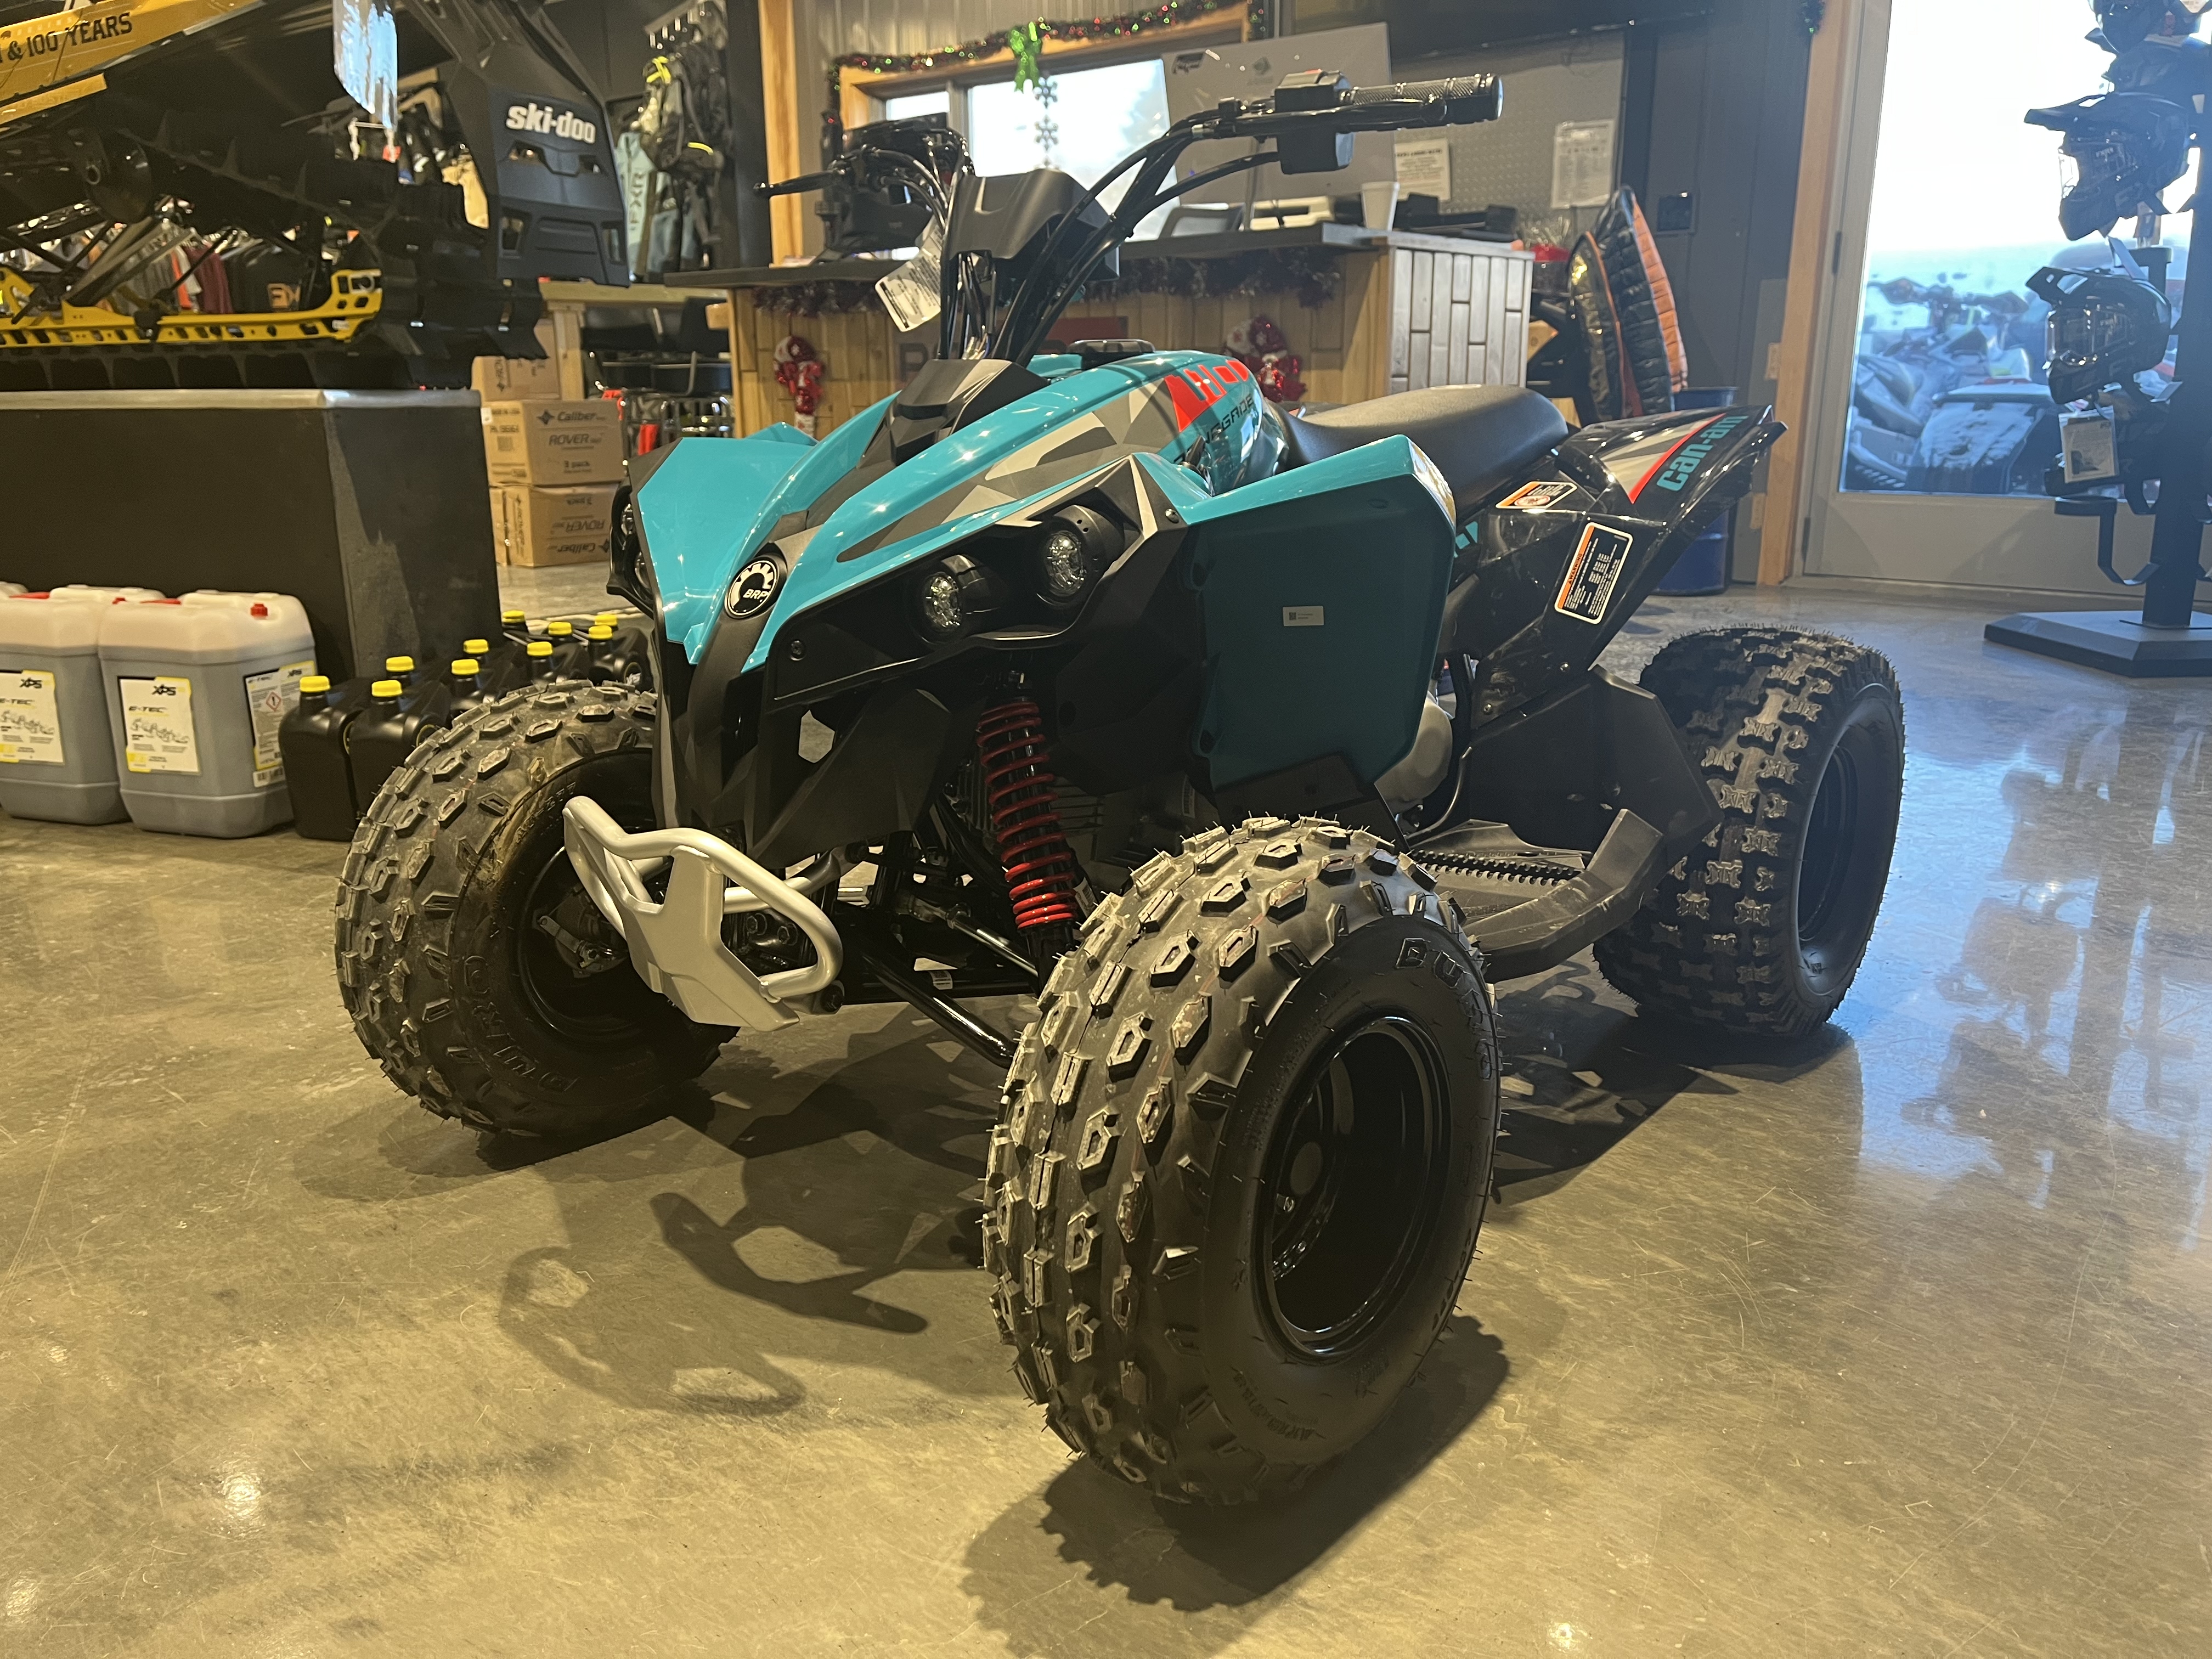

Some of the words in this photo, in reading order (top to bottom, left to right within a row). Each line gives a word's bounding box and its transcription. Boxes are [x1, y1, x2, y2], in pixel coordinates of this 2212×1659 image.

[7, 40, 24, 61] &
[26, 30, 58, 57] 100
[65, 12, 133, 46] YEARS
[1568, 553, 1583, 583] WARNING
[743, 589, 770, 600] BRP
[20, 677, 43, 689] XPS
[151, 684, 177, 696] XPS
